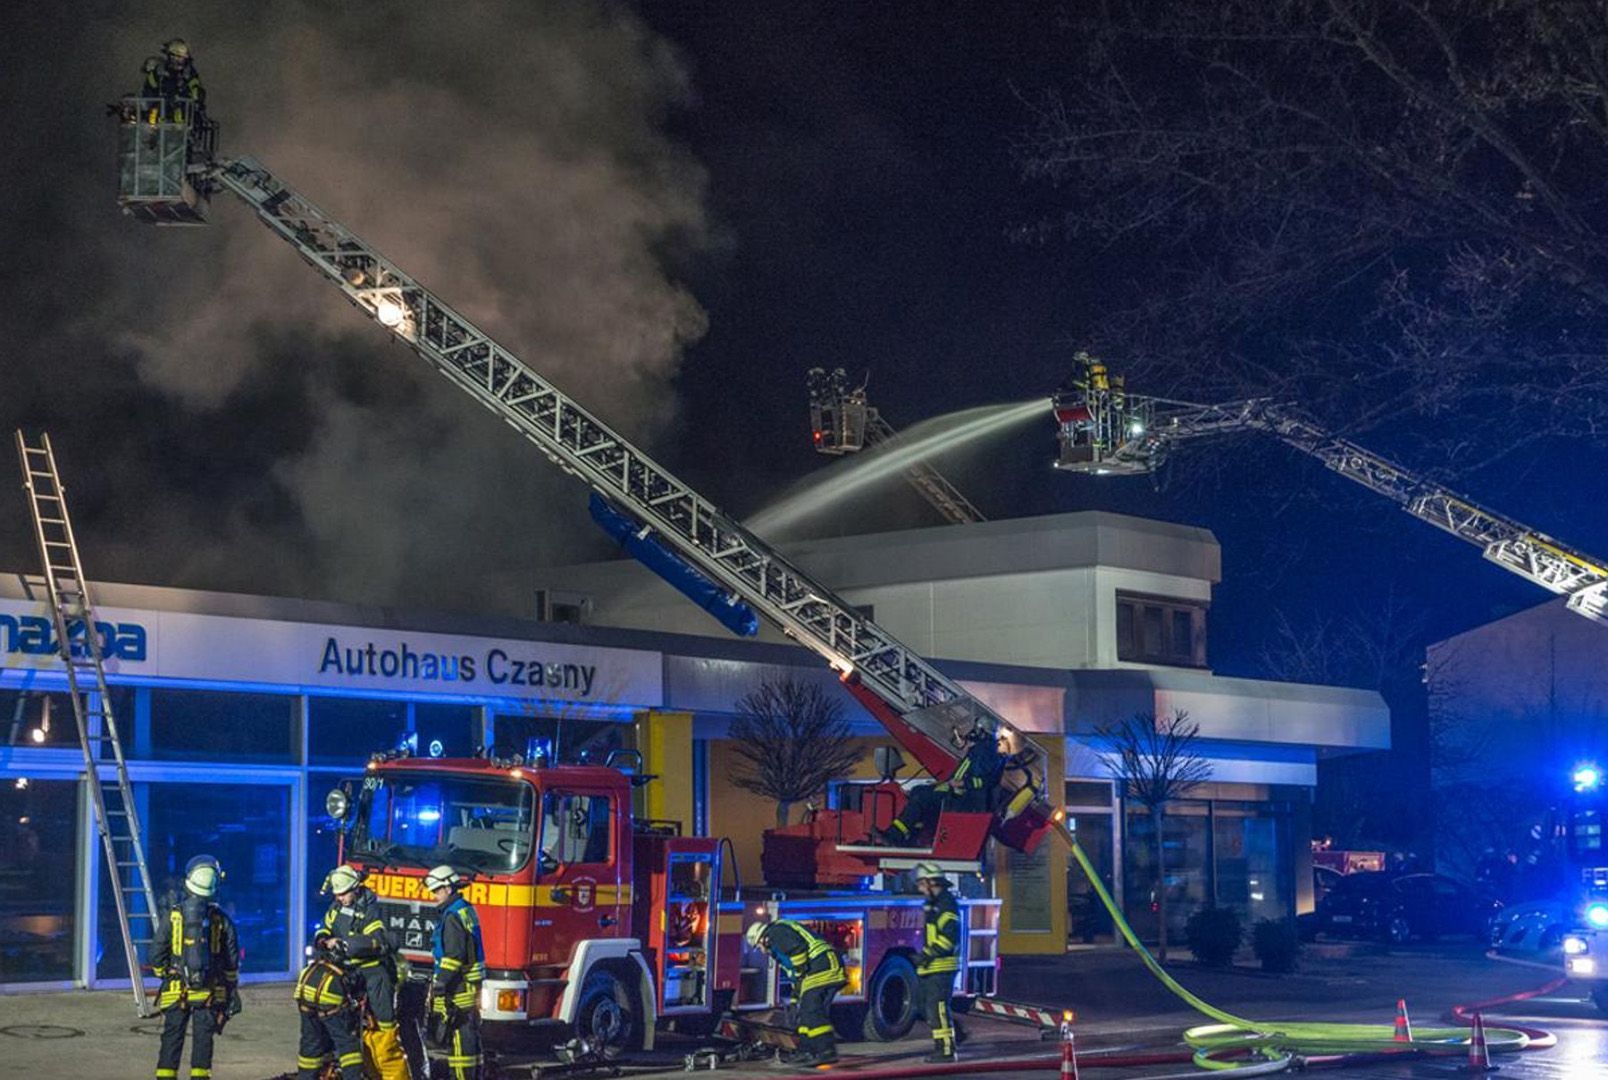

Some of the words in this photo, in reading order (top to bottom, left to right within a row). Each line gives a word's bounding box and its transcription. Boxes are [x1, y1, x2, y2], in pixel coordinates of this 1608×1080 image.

[319, 637, 476, 682] Autohaus
[486, 648, 596, 696] Czasny
[390, 916, 435, 931] MAN
